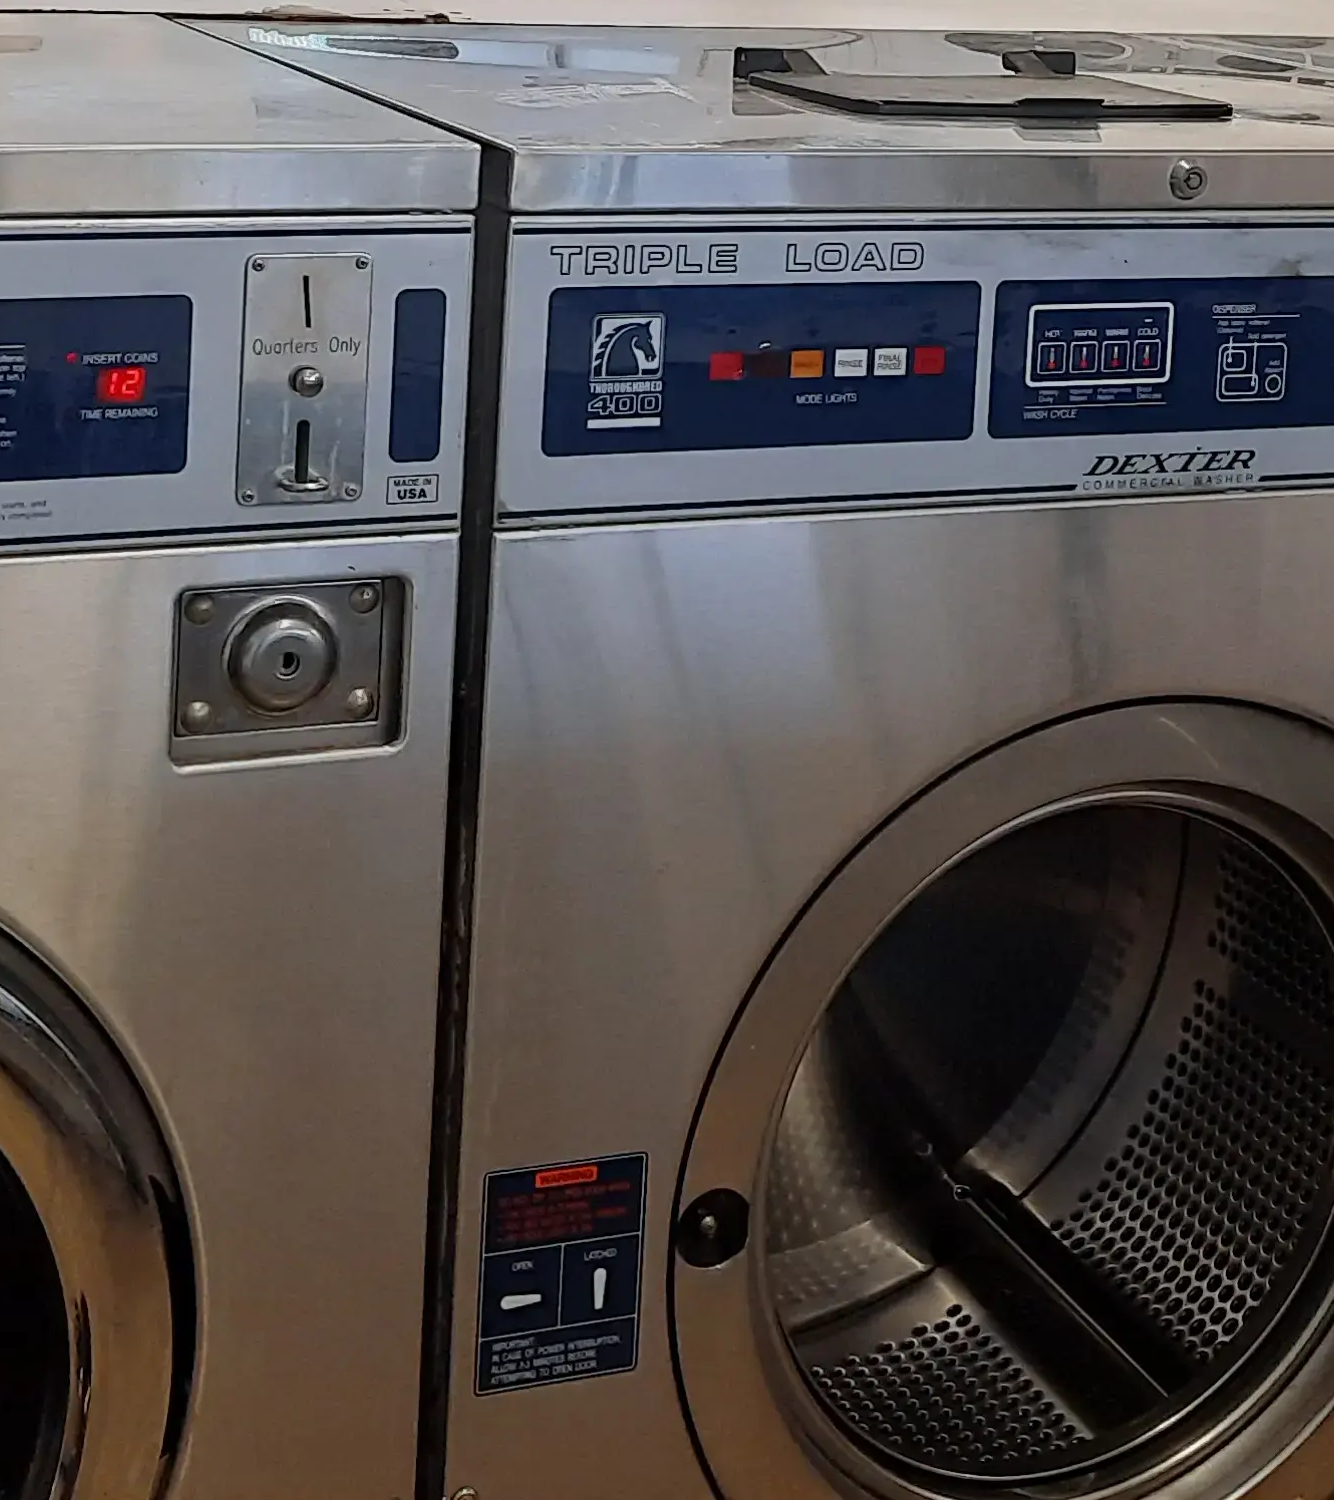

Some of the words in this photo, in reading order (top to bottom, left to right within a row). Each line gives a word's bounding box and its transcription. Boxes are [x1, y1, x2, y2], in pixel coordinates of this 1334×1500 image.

[551, 243, 739, 276] TRIPLE
[785, 242, 924, 273] LOAD
[252, 338, 318, 356] Quarters
[329, 336, 361, 356] Only
[82, 353, 122, 365] INSERT
[124, 352, 158, 363] COINS
[109, 370, 139, 394] 12
[587, 393, 661, 415] 400
[1083, 450, 1256, 476] DEXTER
[1082, 477, 1183, 491] COMMERCIAL
[1193, 473, 1254, 487] WASHER
[397, 489, 427, 501] USA
[539, 1167, 595, 1185] WARNING
